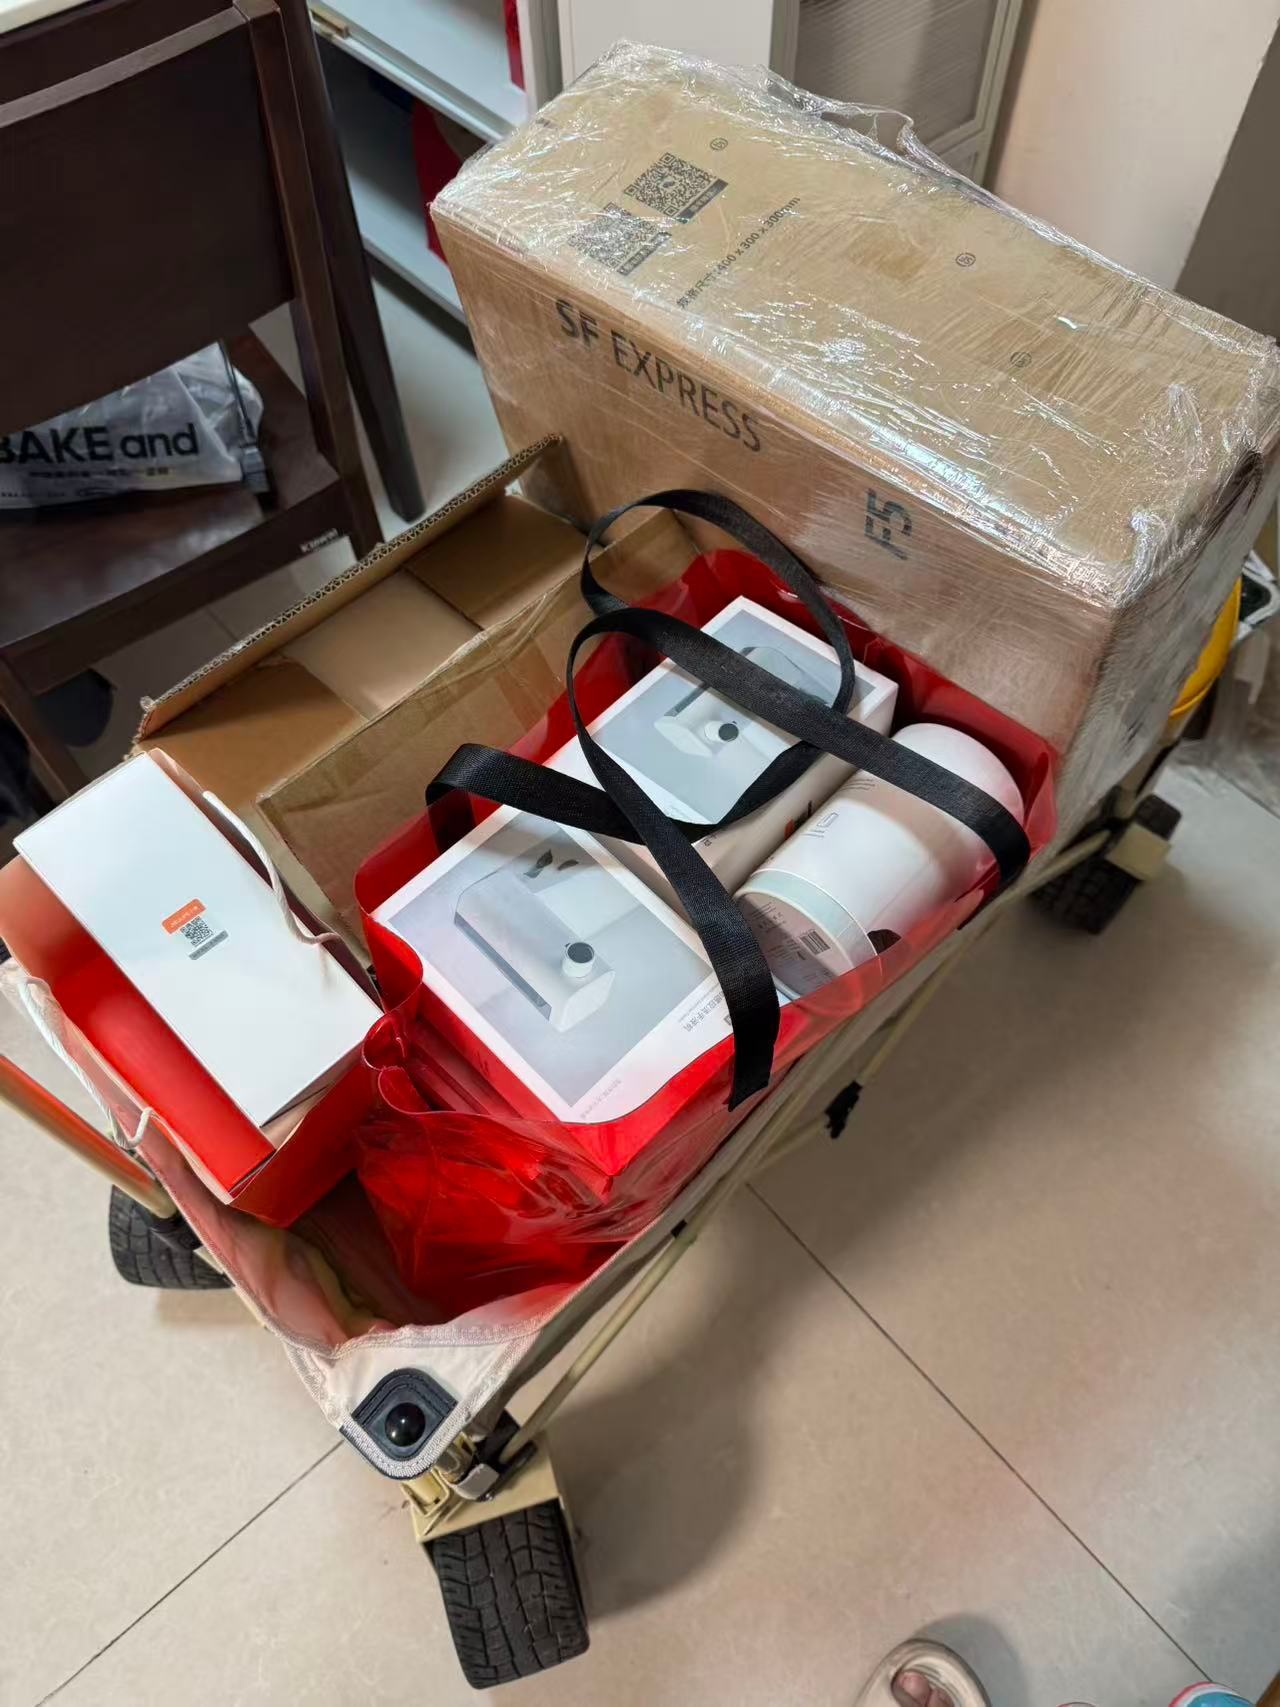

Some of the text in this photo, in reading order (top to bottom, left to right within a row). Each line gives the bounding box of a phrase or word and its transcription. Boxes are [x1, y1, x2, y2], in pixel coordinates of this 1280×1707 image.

[740, 232, 760, 250] 300
[556, 299, 761, 452] SF EXPRESS
[120, 423, 199, 459] and
[864, 488, 912, 560] F5
